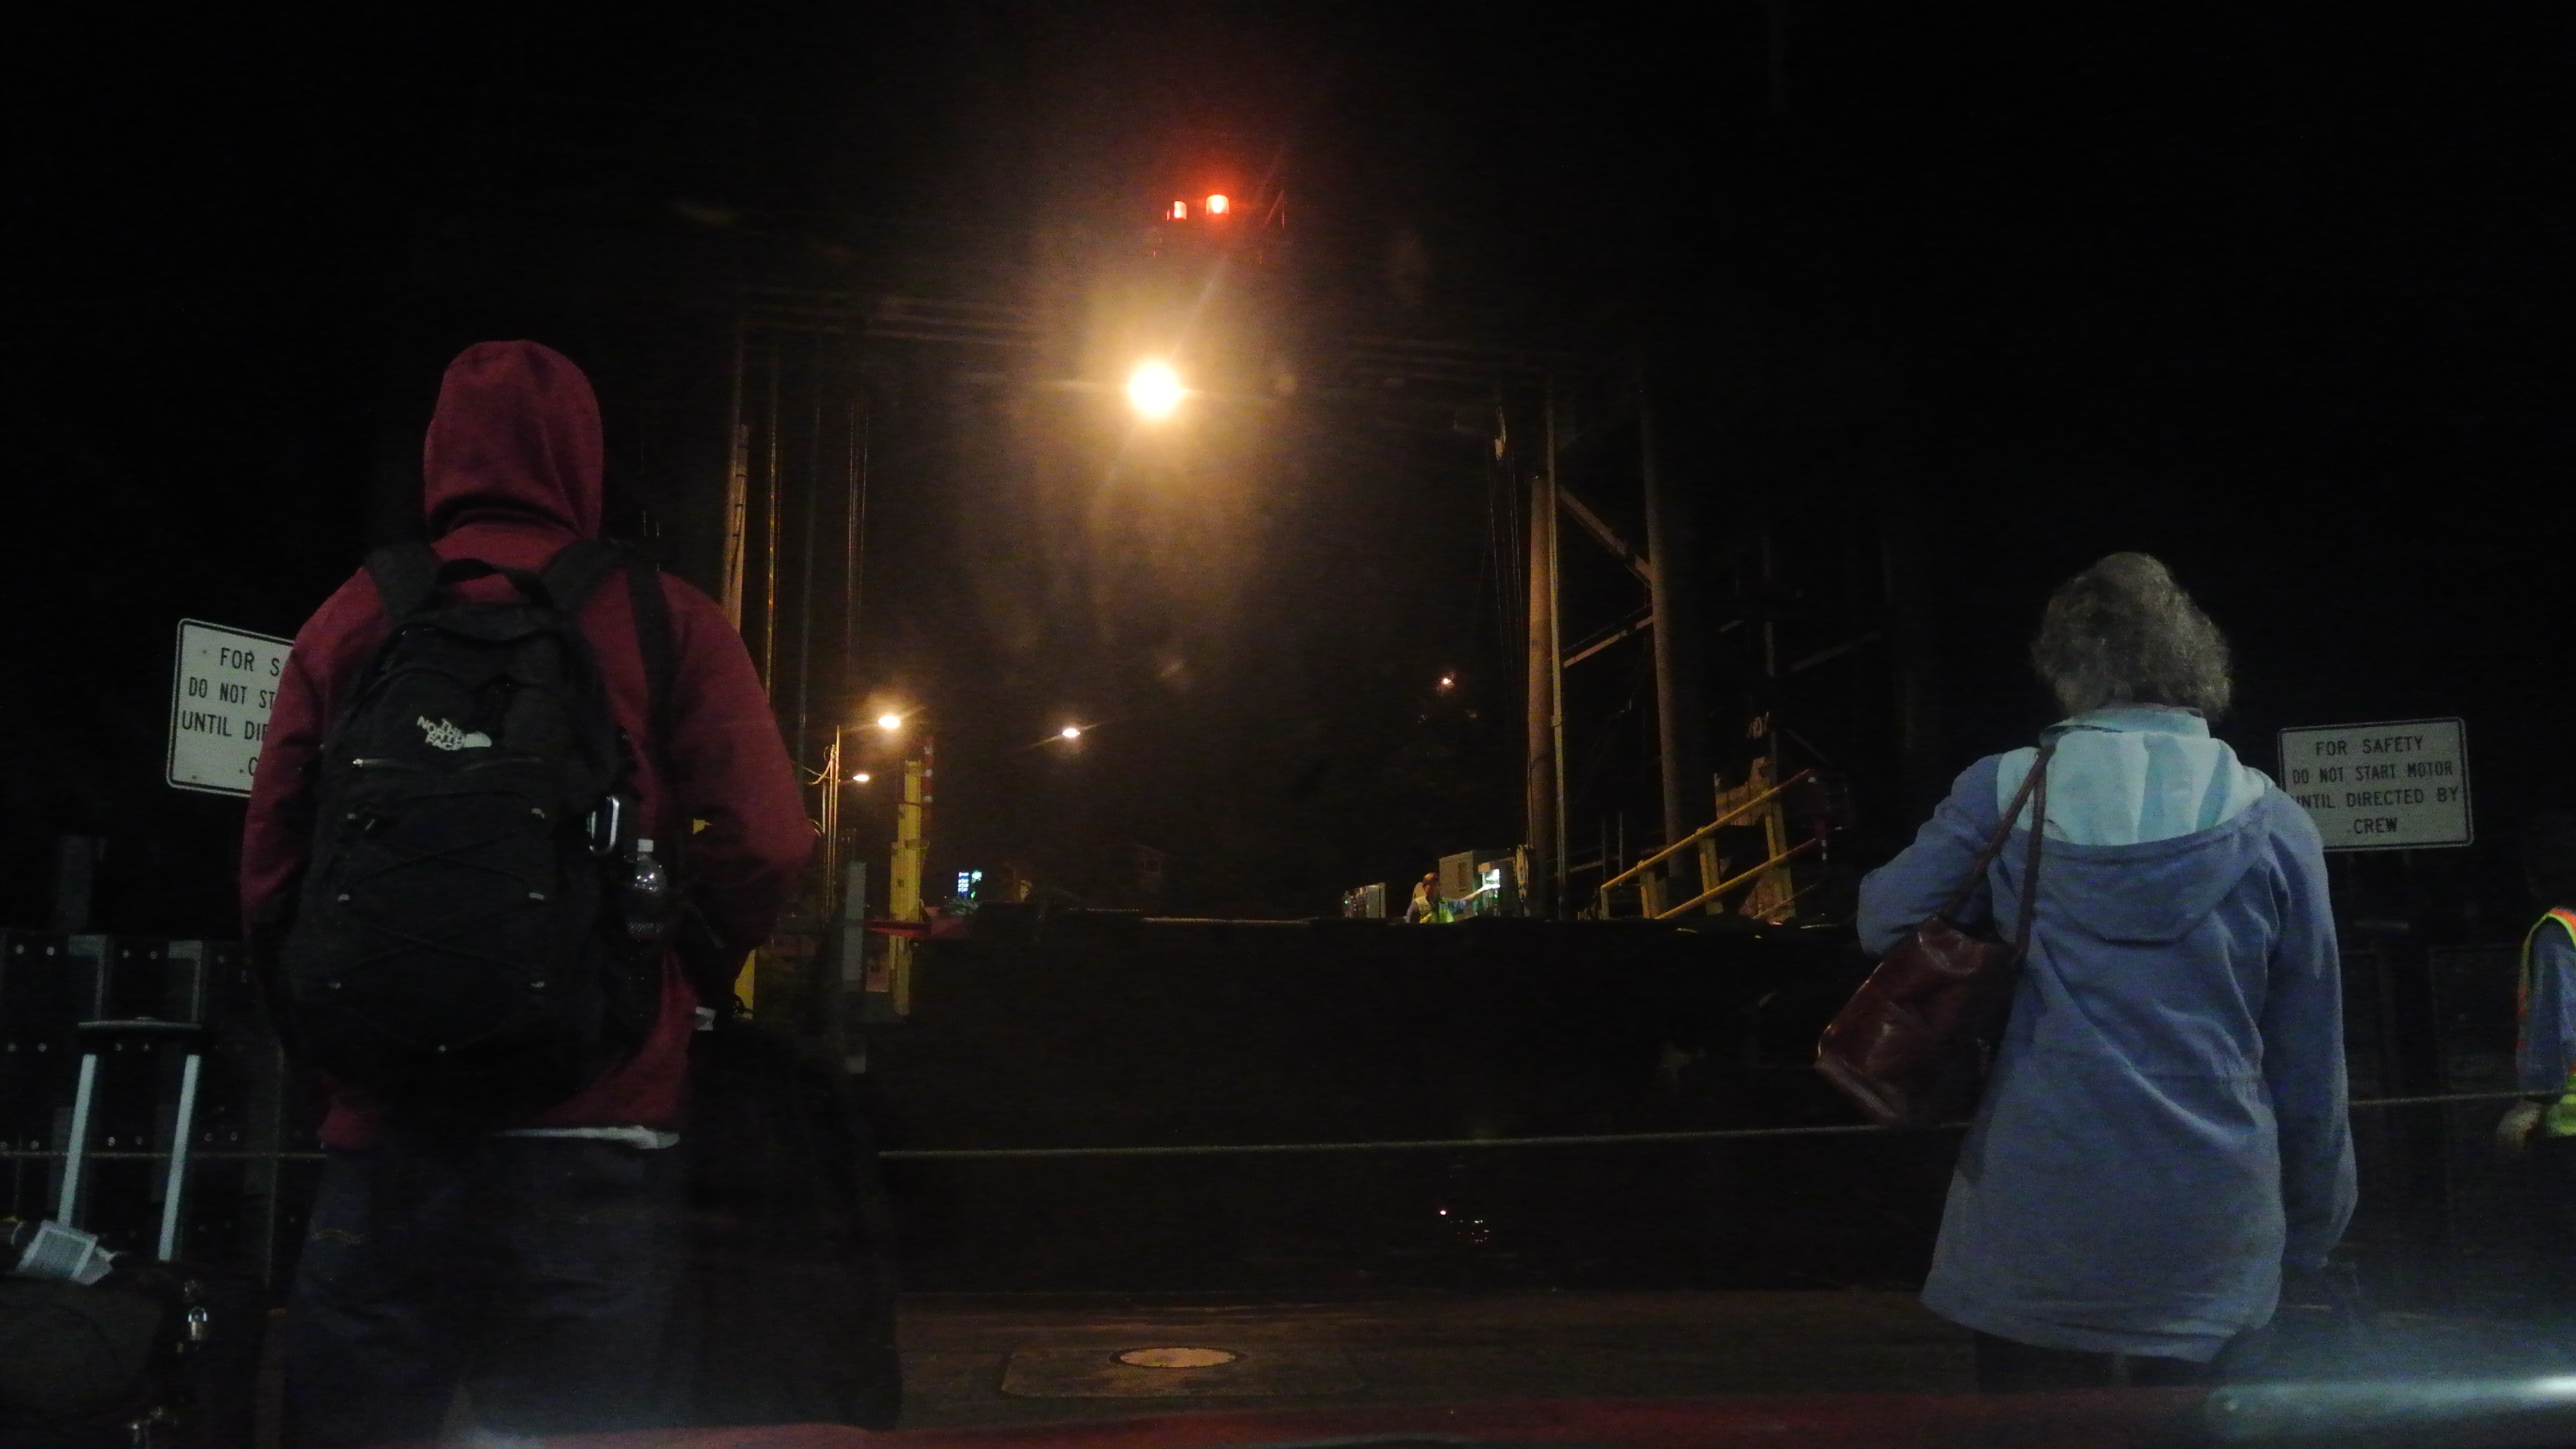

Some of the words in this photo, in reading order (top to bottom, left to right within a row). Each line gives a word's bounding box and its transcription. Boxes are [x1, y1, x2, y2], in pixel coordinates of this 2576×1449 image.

[220, 647, 255, 672] FOR
[189, 676, 207, 698] DO
[219, 682, 248, 704] NOT
[182, 710, 232, 737] UNTIL
[2316, 740, 2347, 756] FOR
[2362, 735, 2424, 754] SAFETY
[2292, 769, 2309, 784] DO
[2320, 767, 2345, 783] NOT
[2355, 764, 2396, 782] START
[2407, 761, 2453, 777] MOTOR
[2346, 789, 2424, 807] DIRECTED
[2437, 786, 2459, 802] BY
[2353, 817, 2398, 835] CREW
